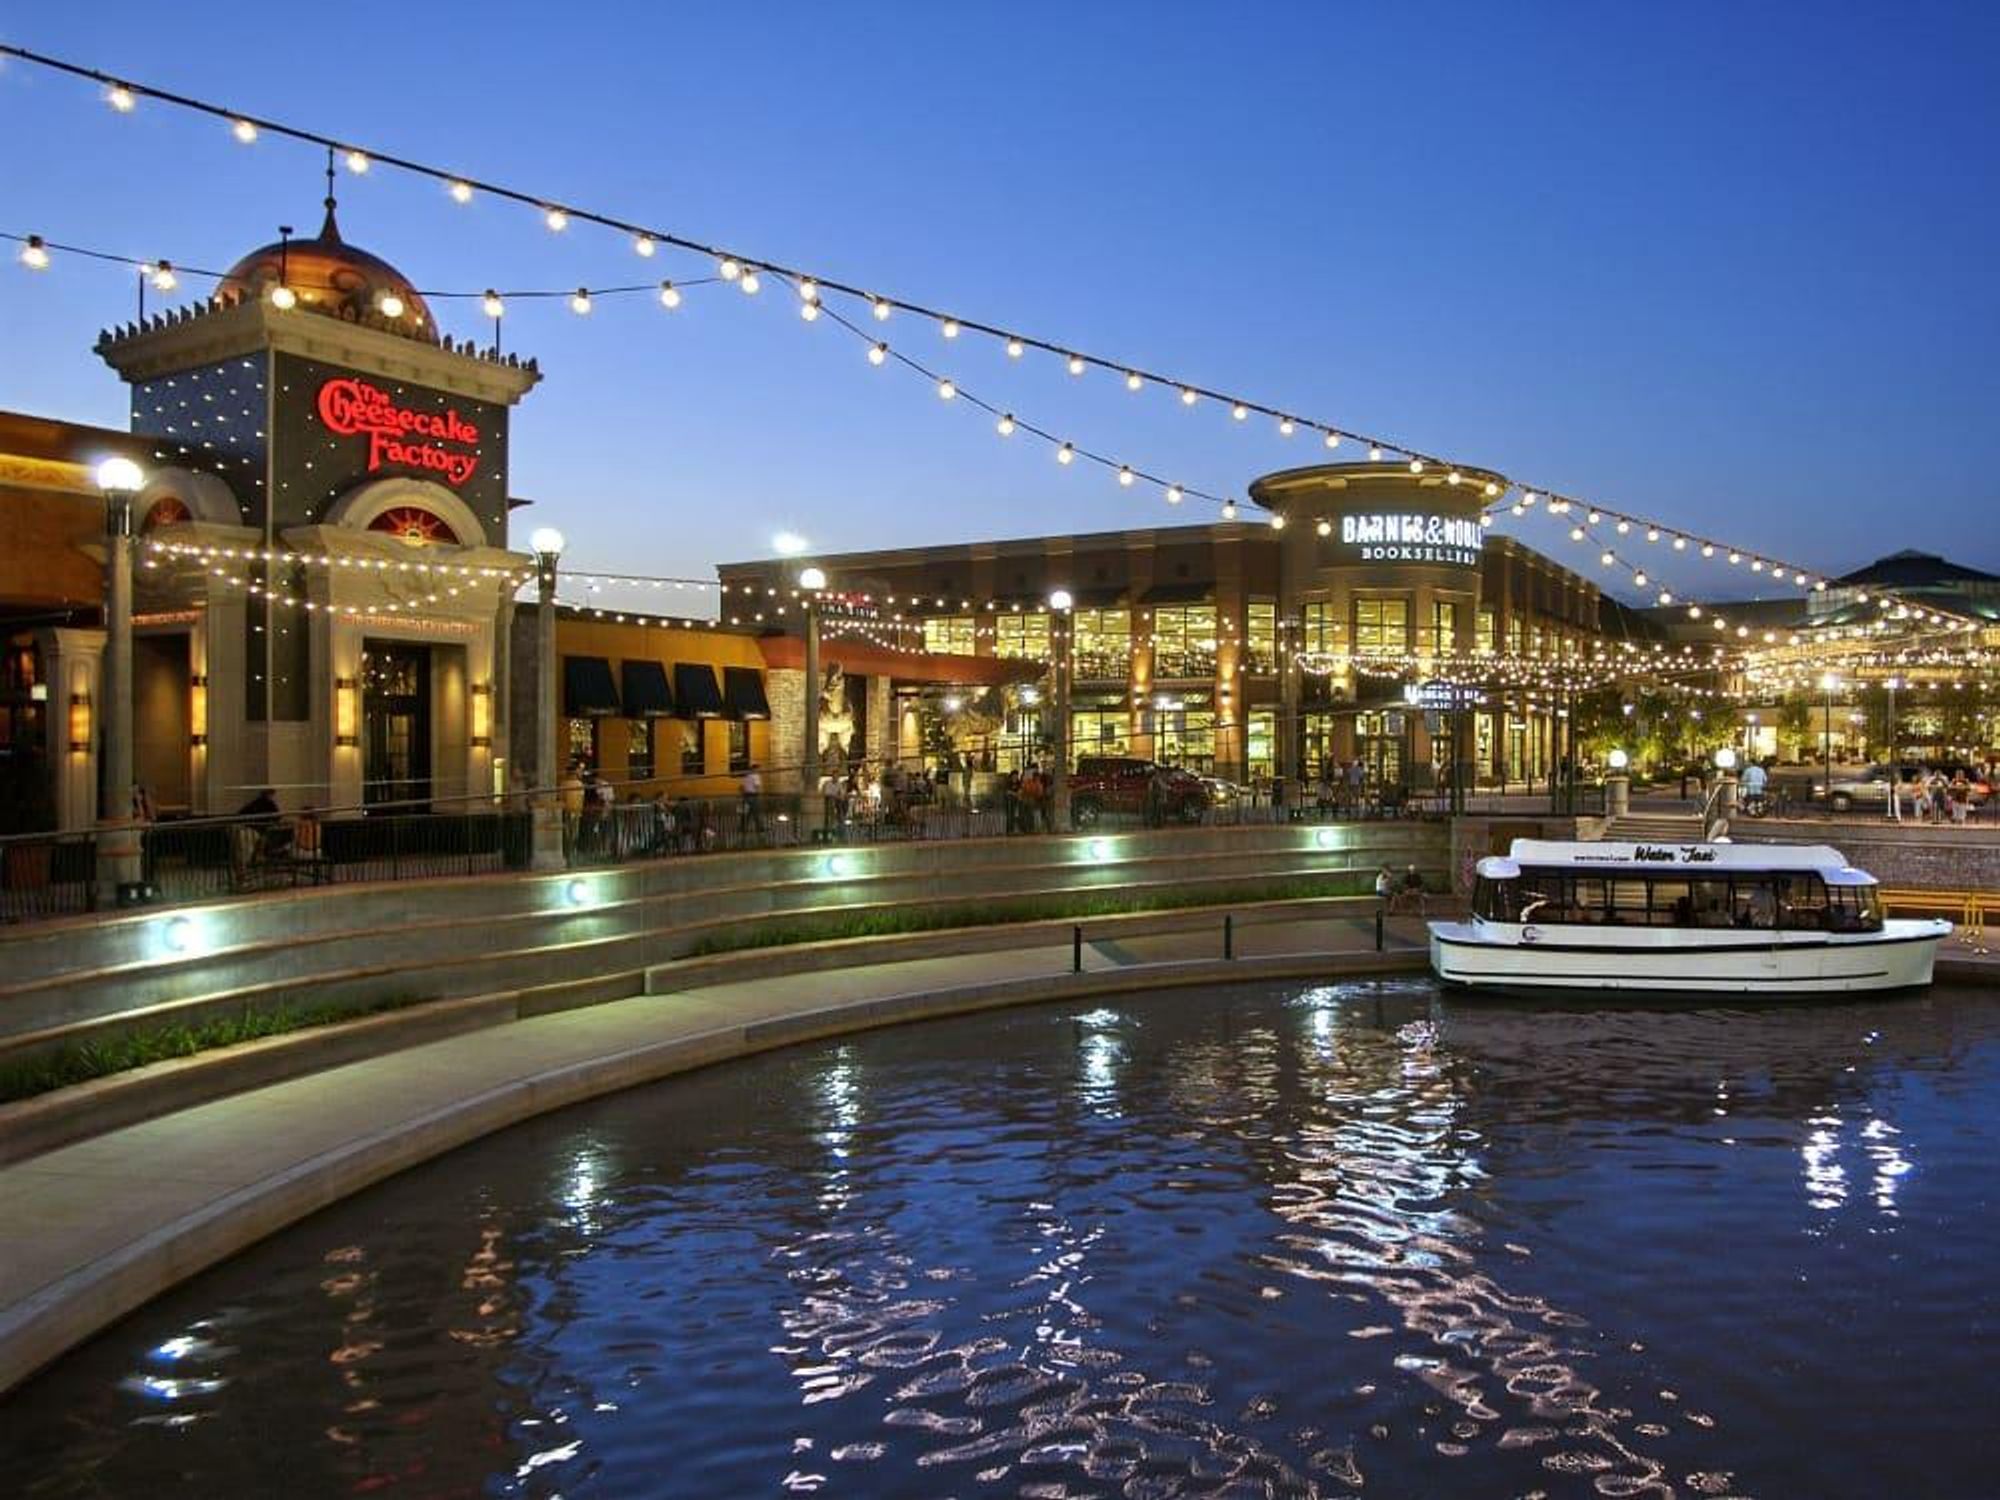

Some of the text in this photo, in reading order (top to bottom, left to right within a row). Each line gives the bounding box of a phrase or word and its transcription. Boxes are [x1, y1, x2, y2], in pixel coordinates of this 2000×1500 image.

[318, 379, 478, 444] Cheesecake
[359, 384, 390, 405] The
[368, 431, 478, 484] Factory
[1634, 845, 1675, 862] Water
[1680, 846, 1717, 863] Taxi
